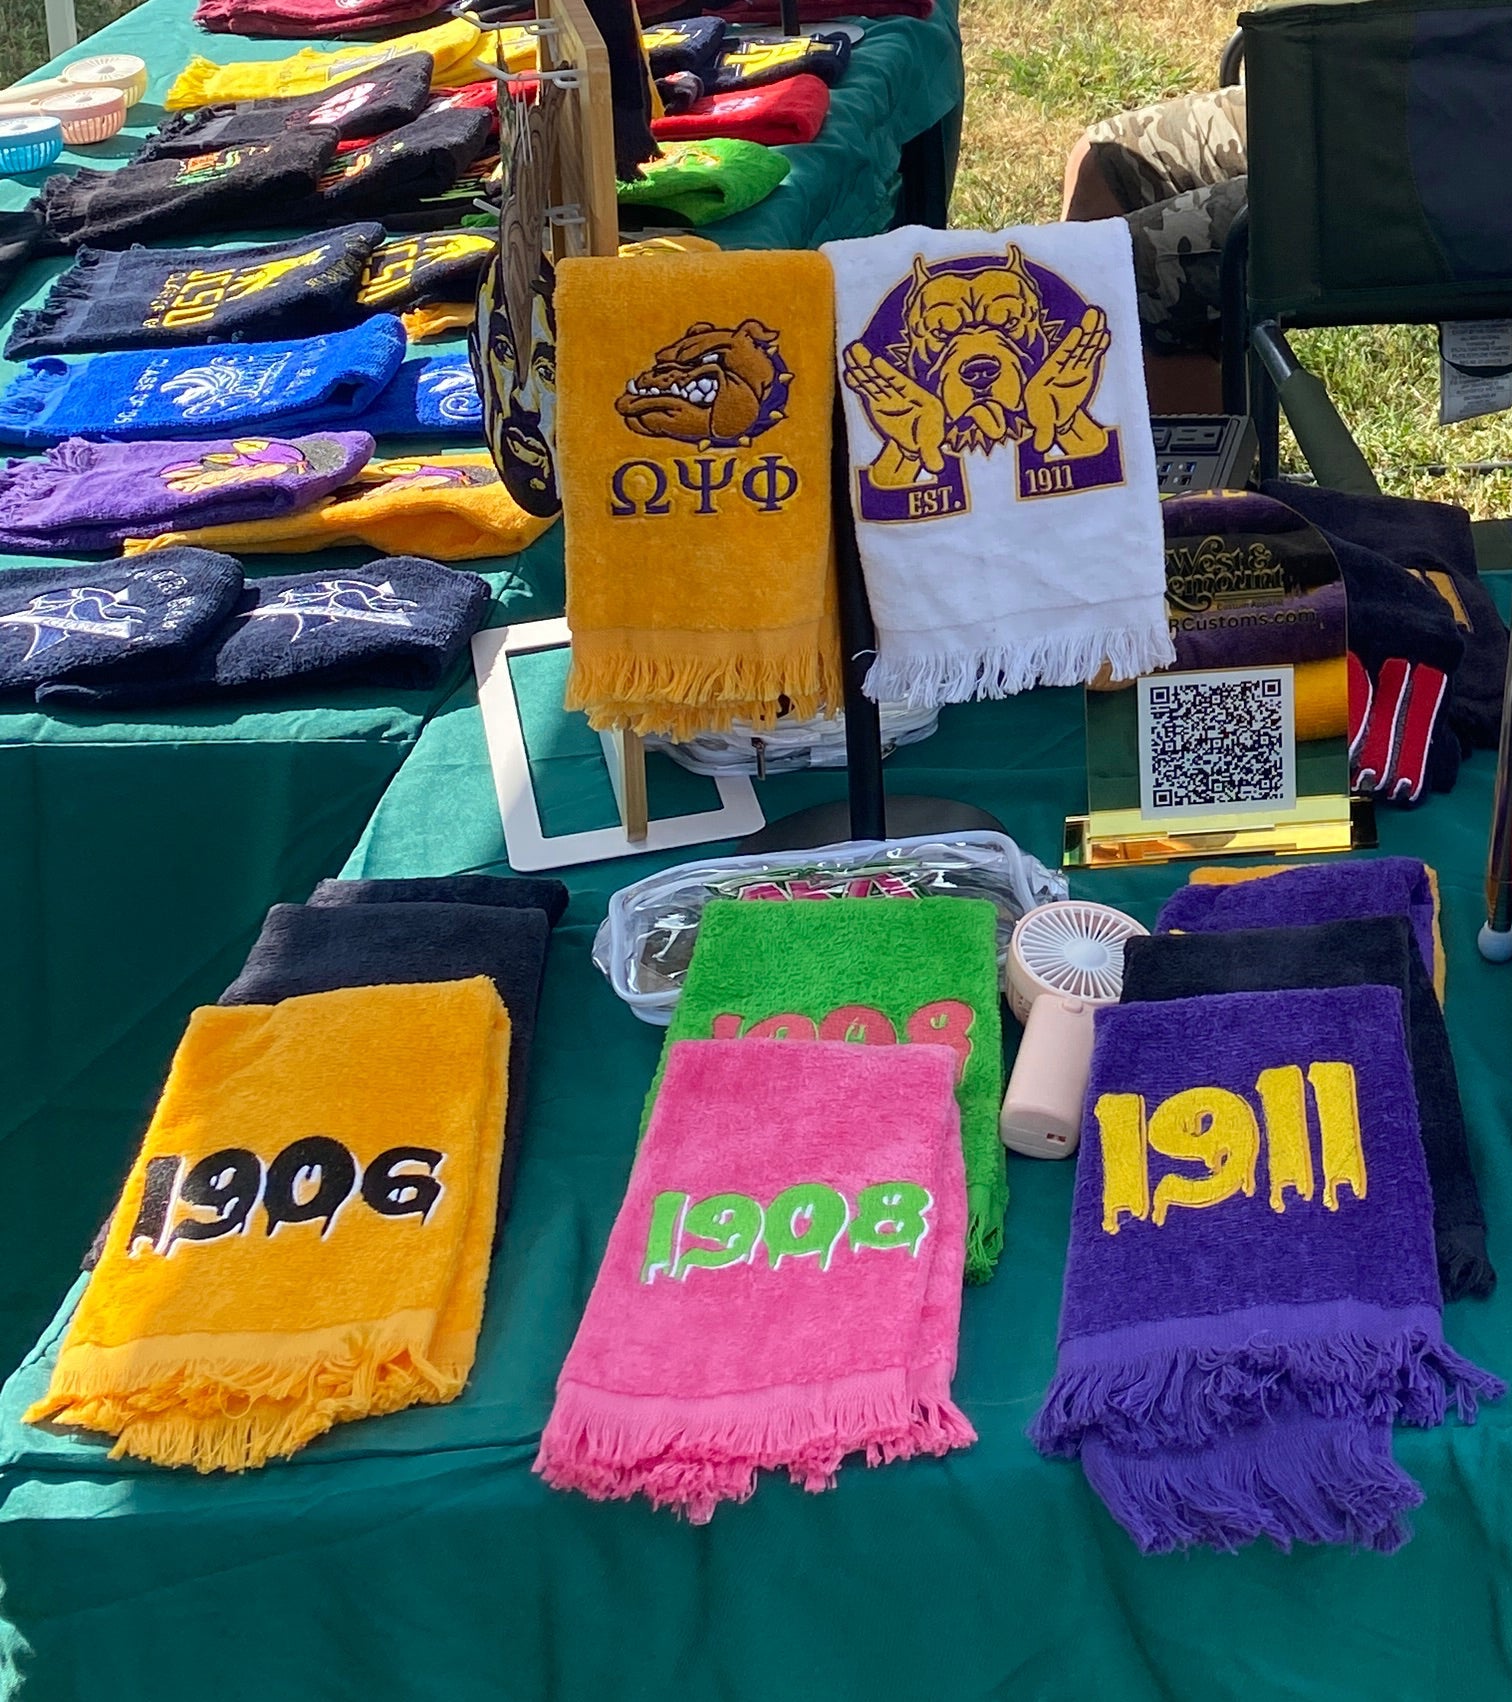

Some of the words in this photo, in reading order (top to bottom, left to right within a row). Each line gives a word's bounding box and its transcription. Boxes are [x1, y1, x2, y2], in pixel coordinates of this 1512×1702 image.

[1024, 465, 1074, 494] 1911
[908, 486, 961, 518] EST.
[1166, 563, 1285, 598] emount
[1167, 607, 1317, 633] RCustoms.com
[1093, 1061, 1368, 1236] 1911
[125, 1134, 448, 1259] 1906
[639, 1180, 936, 1286] 1908
